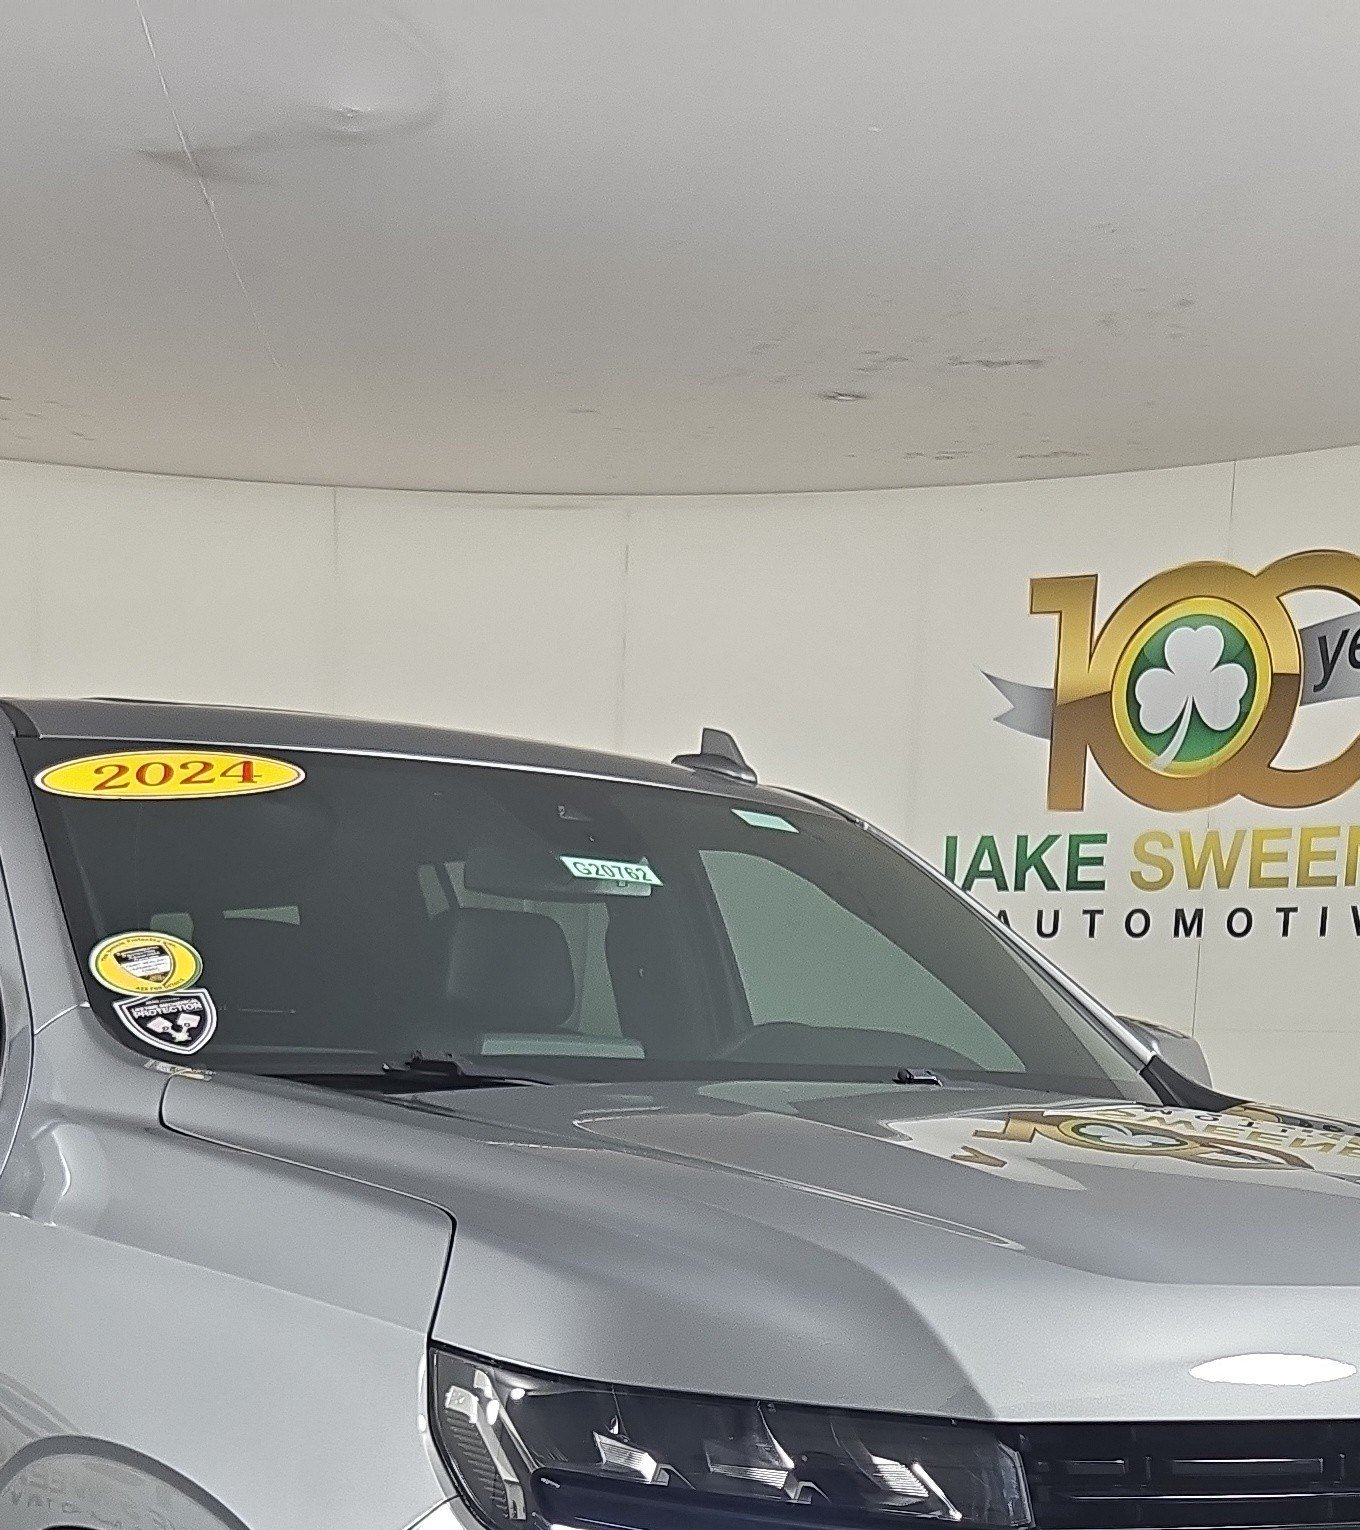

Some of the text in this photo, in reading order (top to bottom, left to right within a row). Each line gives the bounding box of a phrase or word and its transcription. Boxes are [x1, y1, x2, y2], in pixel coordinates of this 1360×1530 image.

[92, 758, 263, 792] 2024
[572, 861, 653, 882] G20762
[944, 832, 1108, 892] JAKE
